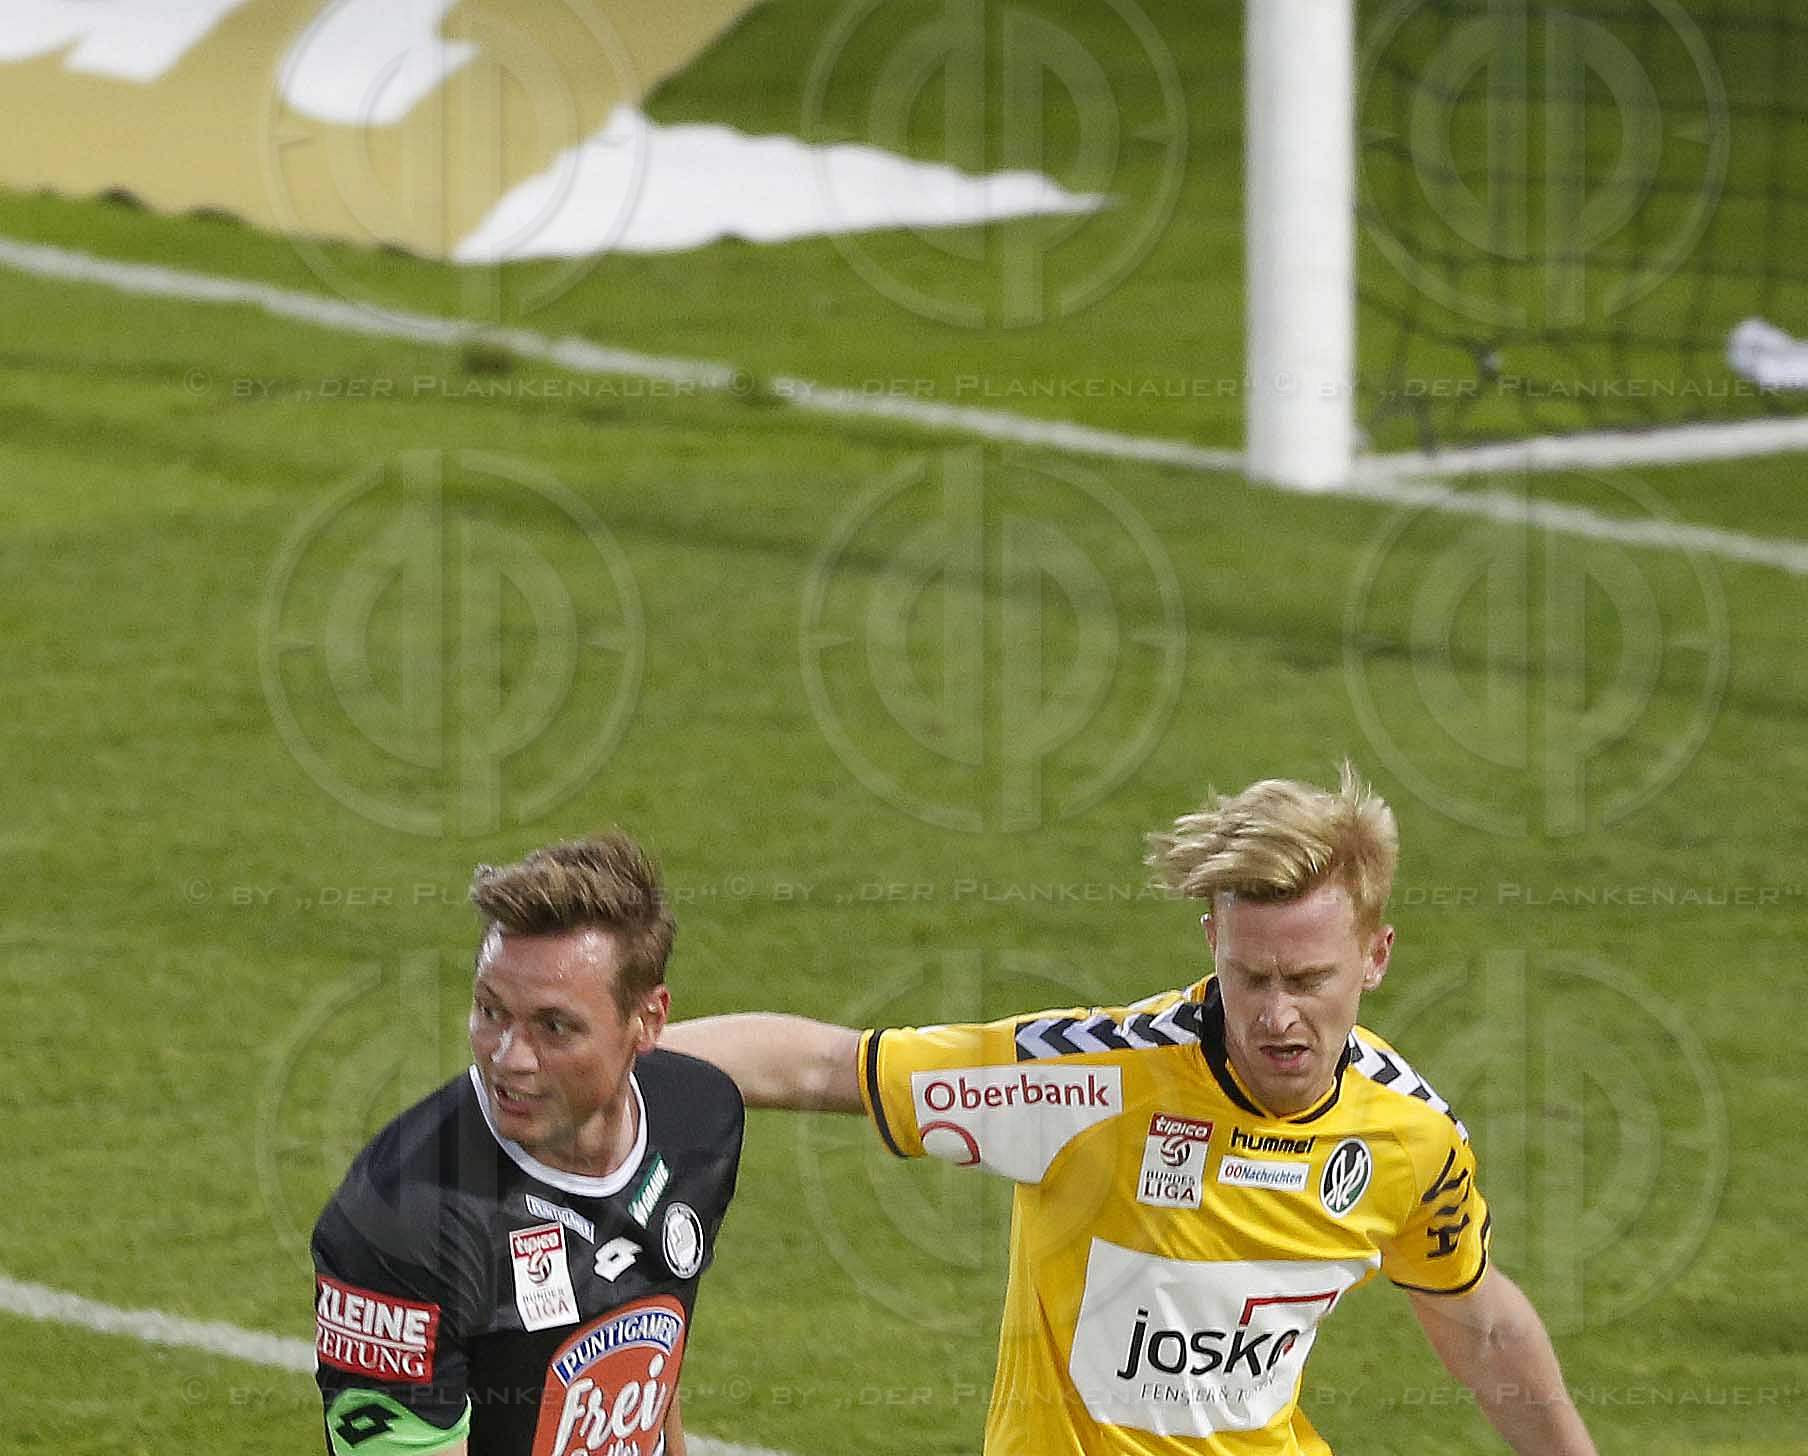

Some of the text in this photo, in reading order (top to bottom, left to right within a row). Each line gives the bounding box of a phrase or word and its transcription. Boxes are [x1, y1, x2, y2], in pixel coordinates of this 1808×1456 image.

[924, 1074, 1110, 1112] Oberbank
[1156, 1116, 1208, 1137] tipico
[1230, 1127, 1315, 1154] hummel
[1143, 1181, 1196, 1203] LIGA
